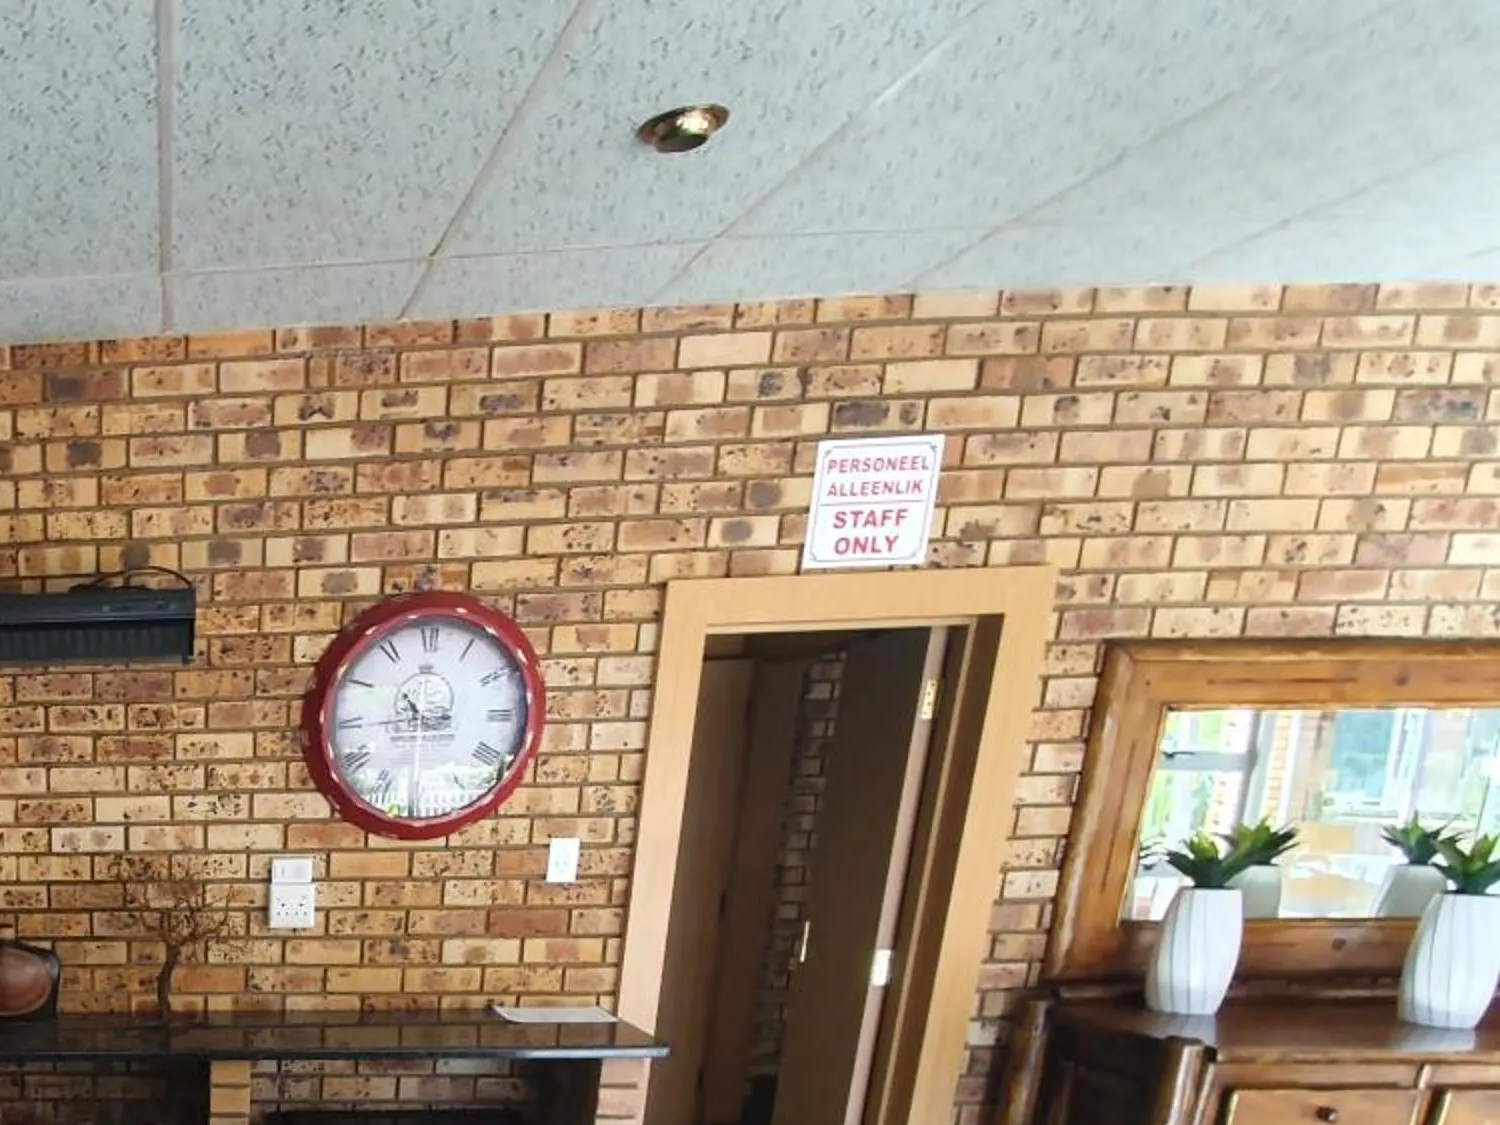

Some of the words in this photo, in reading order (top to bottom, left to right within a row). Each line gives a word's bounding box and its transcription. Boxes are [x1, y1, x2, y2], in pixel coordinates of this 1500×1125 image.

[827, 455, 930, 474] PERSONEEL
[827, 479, 923, 497] ALLEENLIK
[833, 508, 909, 529] STAFF
[834, 535, 899, 555] ONLY
